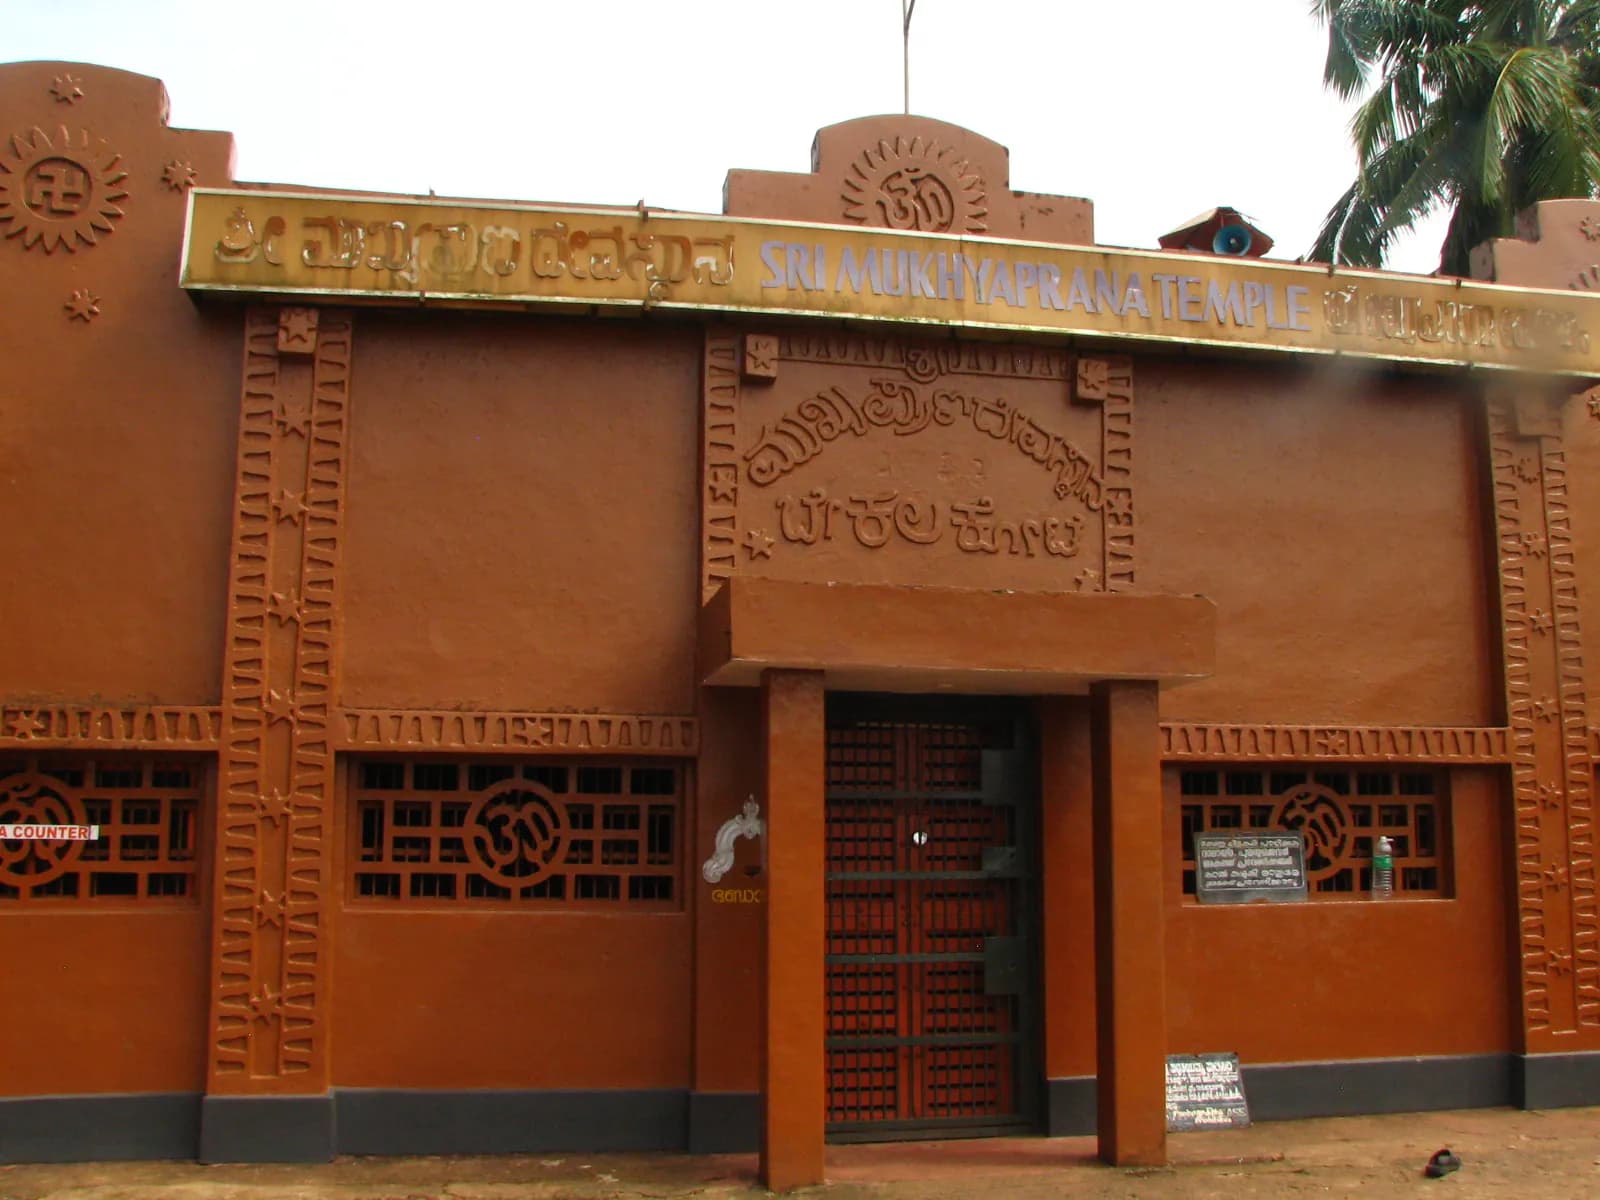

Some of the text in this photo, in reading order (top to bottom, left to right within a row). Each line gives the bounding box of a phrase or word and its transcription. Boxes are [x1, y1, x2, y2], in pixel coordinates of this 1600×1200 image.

[214, 206, 287, 266] ಶ್ರೀ
[760, 239, 1312, 332] SRI MUKHYAPRANA TEMPLE
[13, 826, 88, 838] COUNTER
